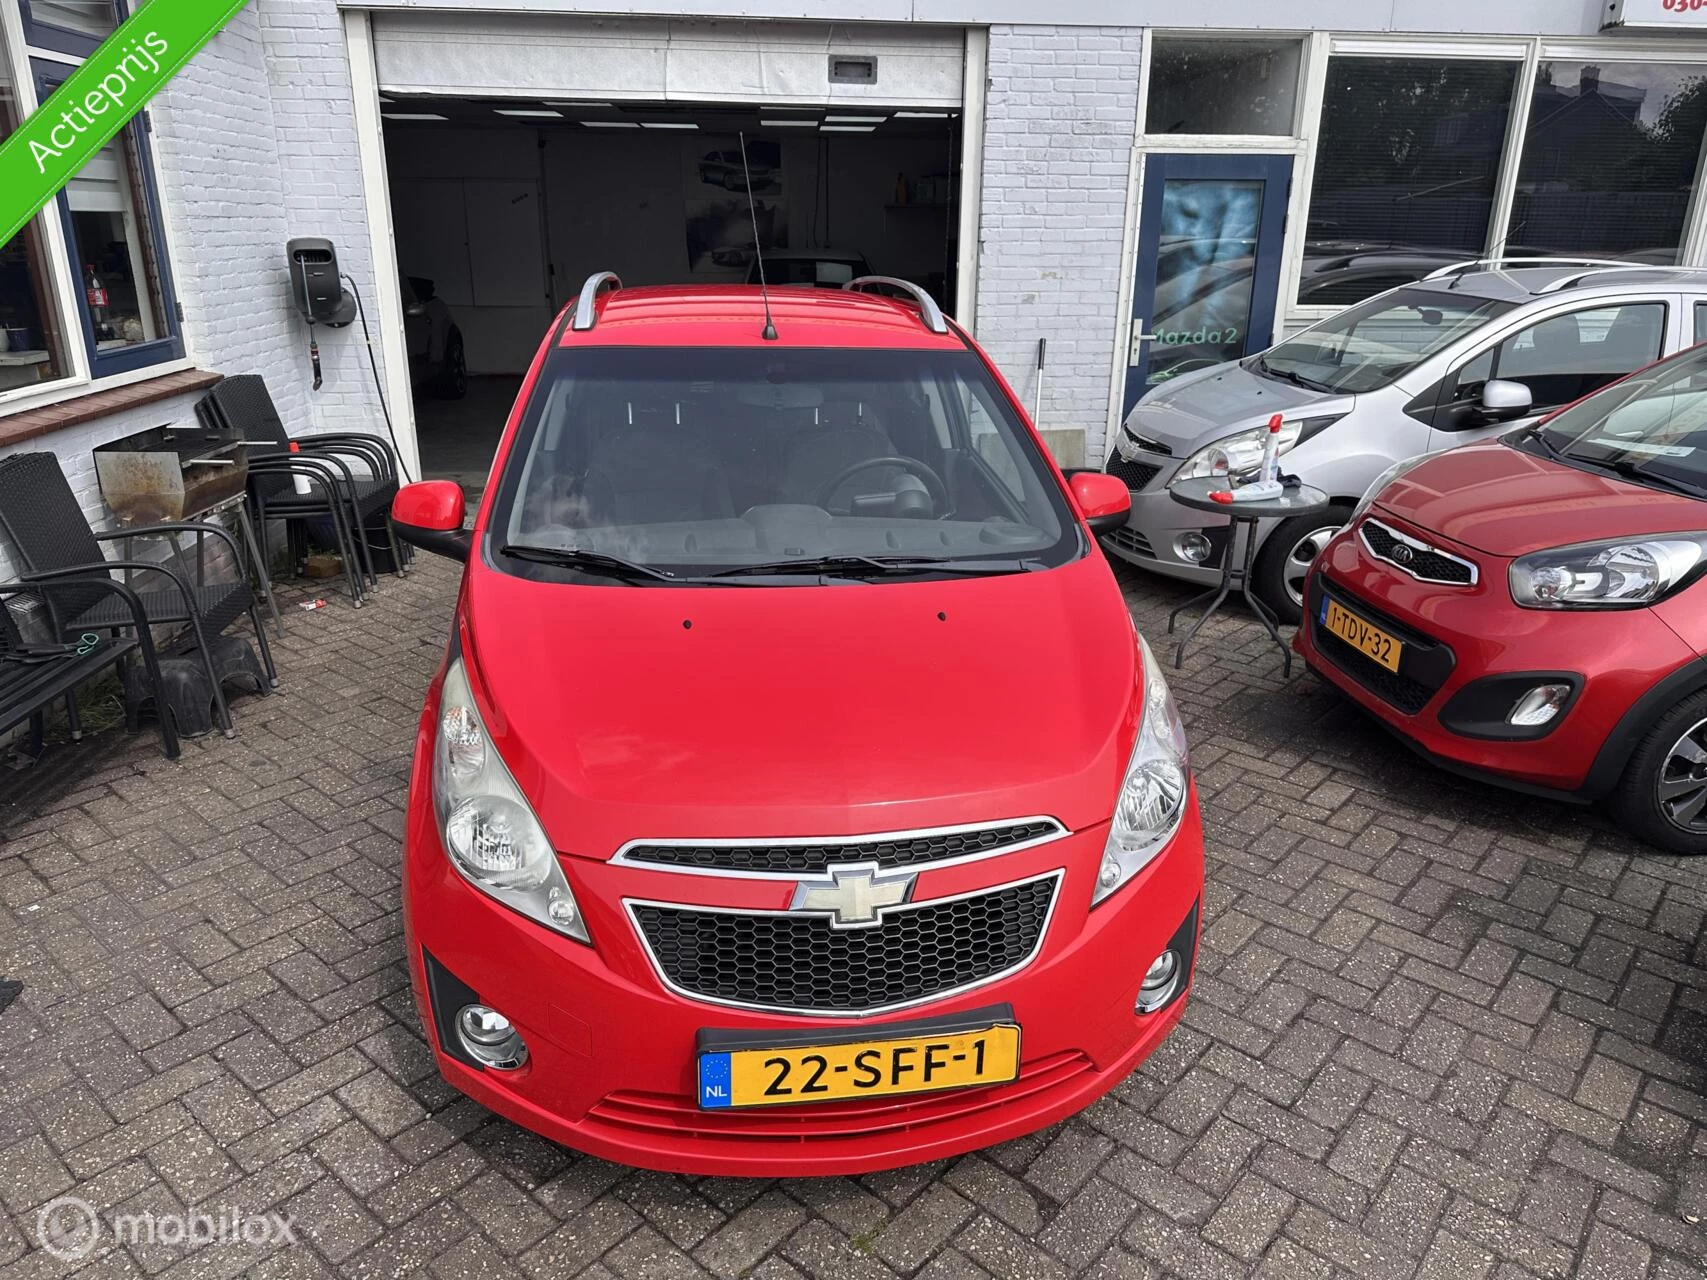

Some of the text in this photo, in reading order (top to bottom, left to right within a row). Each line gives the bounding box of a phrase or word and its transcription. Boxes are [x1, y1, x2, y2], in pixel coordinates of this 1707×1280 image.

[1331, 607, 1392, 663] 1-TDV-32
[705, 1085, 727, 1098] NL
[763, 1039, 986, 1096] 22-SFF-1
